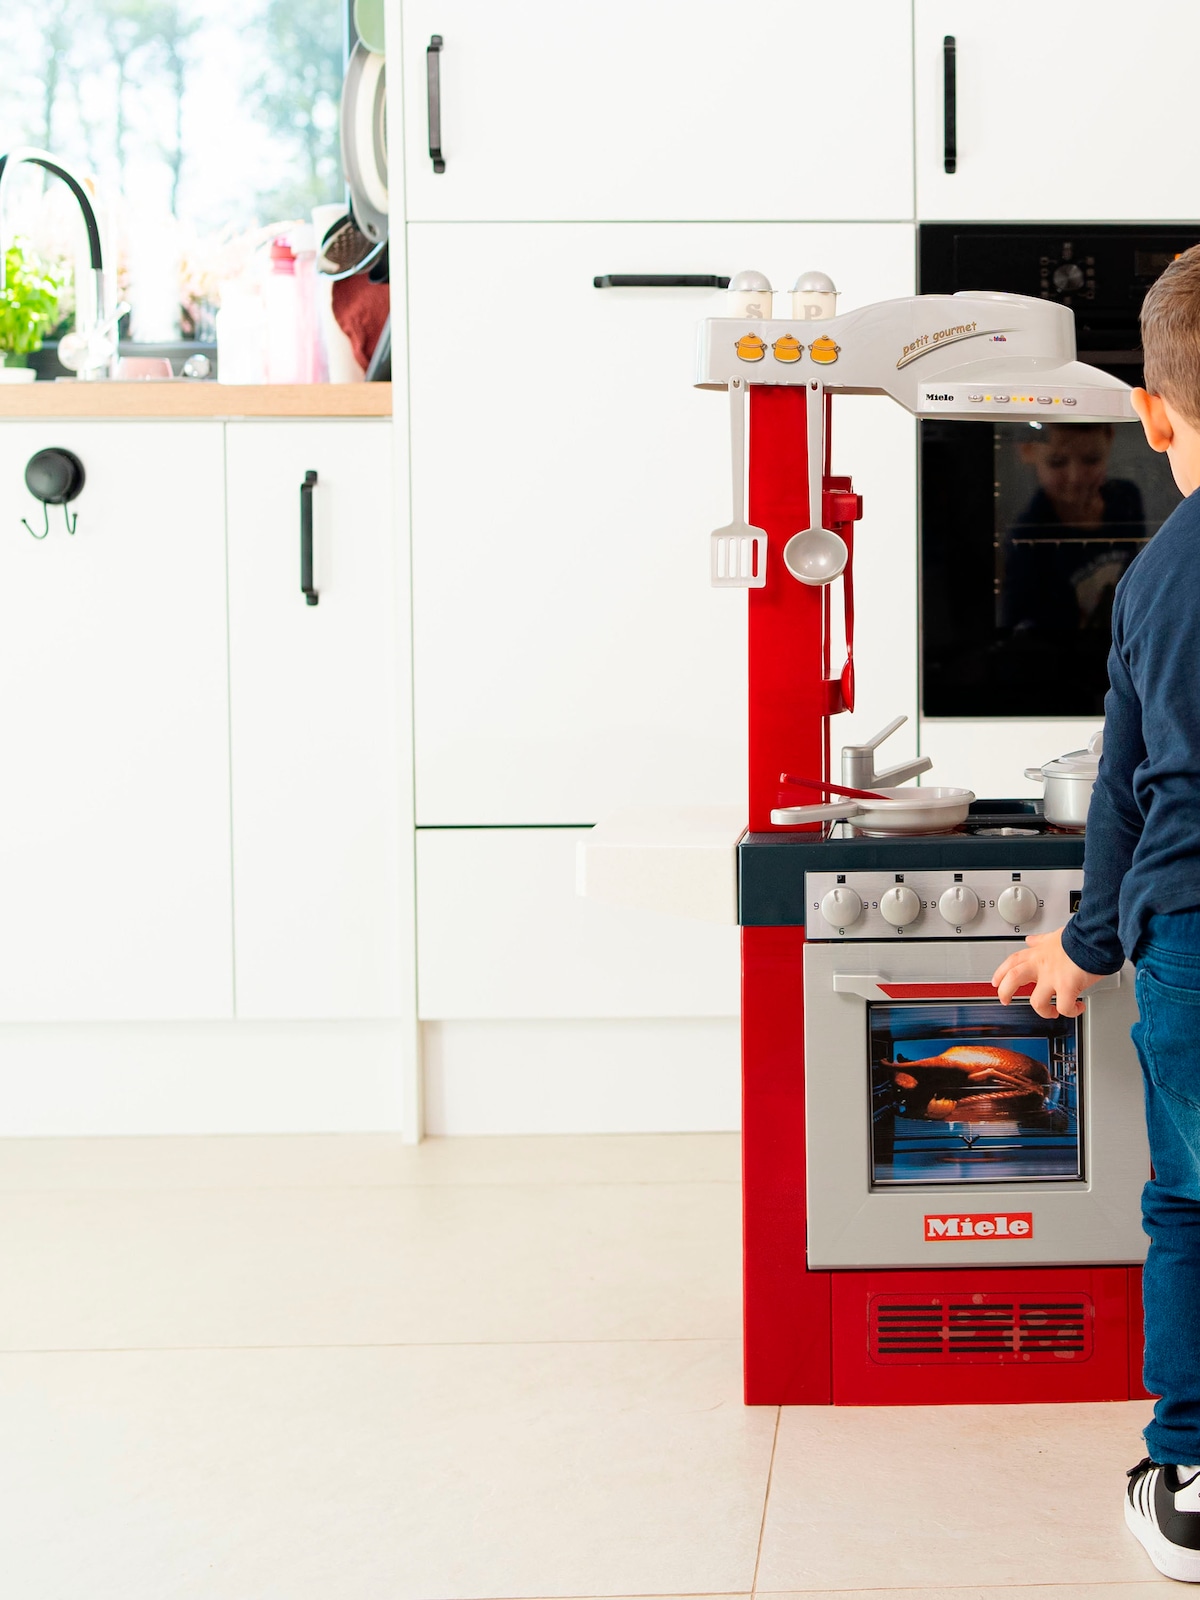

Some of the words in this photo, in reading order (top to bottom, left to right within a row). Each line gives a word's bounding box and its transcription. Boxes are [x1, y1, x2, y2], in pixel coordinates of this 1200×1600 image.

[902, 334, 929, 356] petit
[932, 321, 977, 342] gourmet
[925, 393, 954, 401] Miele
[813, 902, 820, 910] 9
[863, 902, 869, 910] 3
[872, 901, 878, 909] 9
[922, 901, 928, 909] 3
[980, 900, 986, 908] 3
[989, 900, 995, 908] 9
[956, 926, 962, 934] 6
[1014, 925, 1020, 933] 6
[927, 1217, 1030, 1237] Miele
